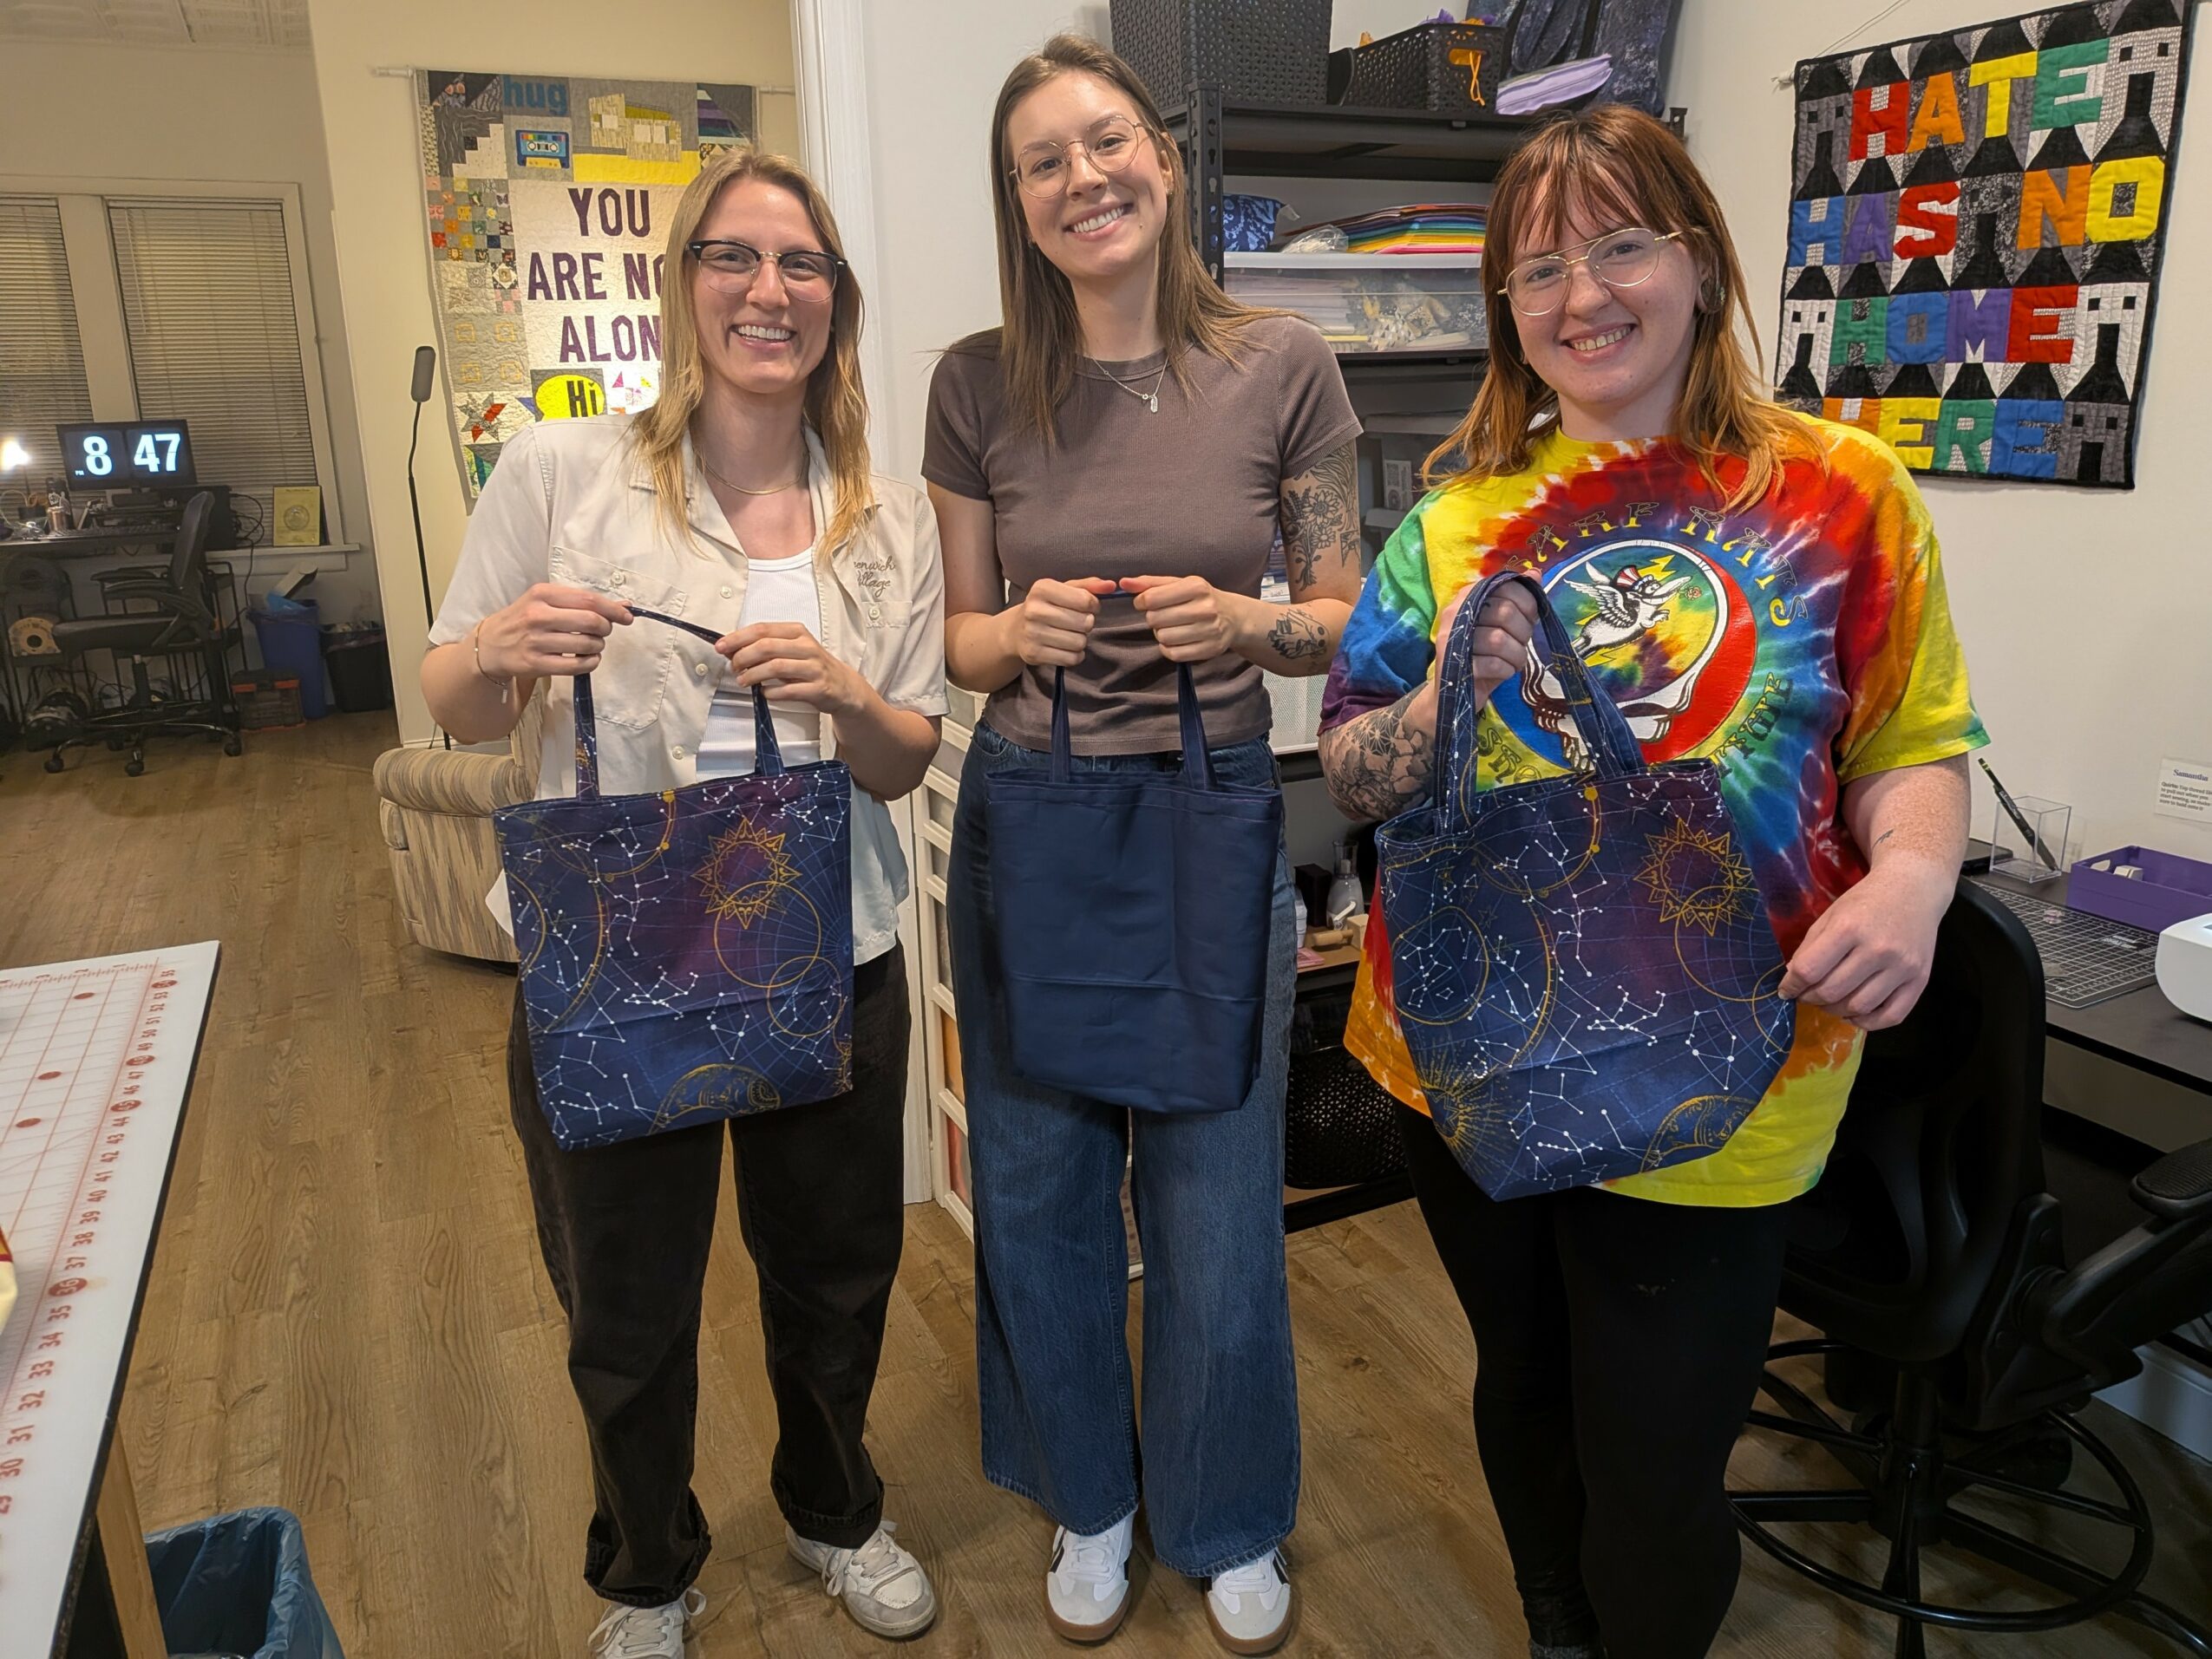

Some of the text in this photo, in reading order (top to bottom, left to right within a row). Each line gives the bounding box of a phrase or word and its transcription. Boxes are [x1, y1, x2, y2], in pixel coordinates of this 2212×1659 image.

[503, 75, 569, 116] hug
[1848, 38, 2110, 161] HATE
[568, 188, 651, 238] YOU
[1787, 156, 2166, 267] HAS NO
[527, 252, 606, 300] ARE
[1829, 285, 2078, 366] HOME
[560, 315, 661, 362] ALON
[566, 380, 598, 417] Hi
[83, 433, 180, 475] 8 47
[854, 555, 895, 572] enwich
[1679, 506, 1809, 627] RATS
[2173, 768, 2209, 781] Samantha
[154, 991, 168, 1000] 53
[149, 1003, 165, 1012] 52
[141, 1029, 158, 1038] 50
[137, 1042, 153, 1051] 49
[123, 1085, 140, 1094] 46
[112, 1116, 130, 1127] 44
[106, 1133, 125, 1144] 43
[101, 1151, 120, 1162] 42
[94, 1171, 113, 1181] 41
[88, 1190, 108, 1202] 40
[80, 1211, 101, 1225] 39
[72, 1231, 94, 1246] 38
[64, 1257, 87, 1270] 37
[56, 1279, 81, 1295] 36
[48, 1305, 71, 1322] 35
[38, 1332, 63, 1349] 34
[28, 1361, 54, 1379] 33
[18, 1390, 45, 1411] 32
[7, 1425, 35, 1445] 31
